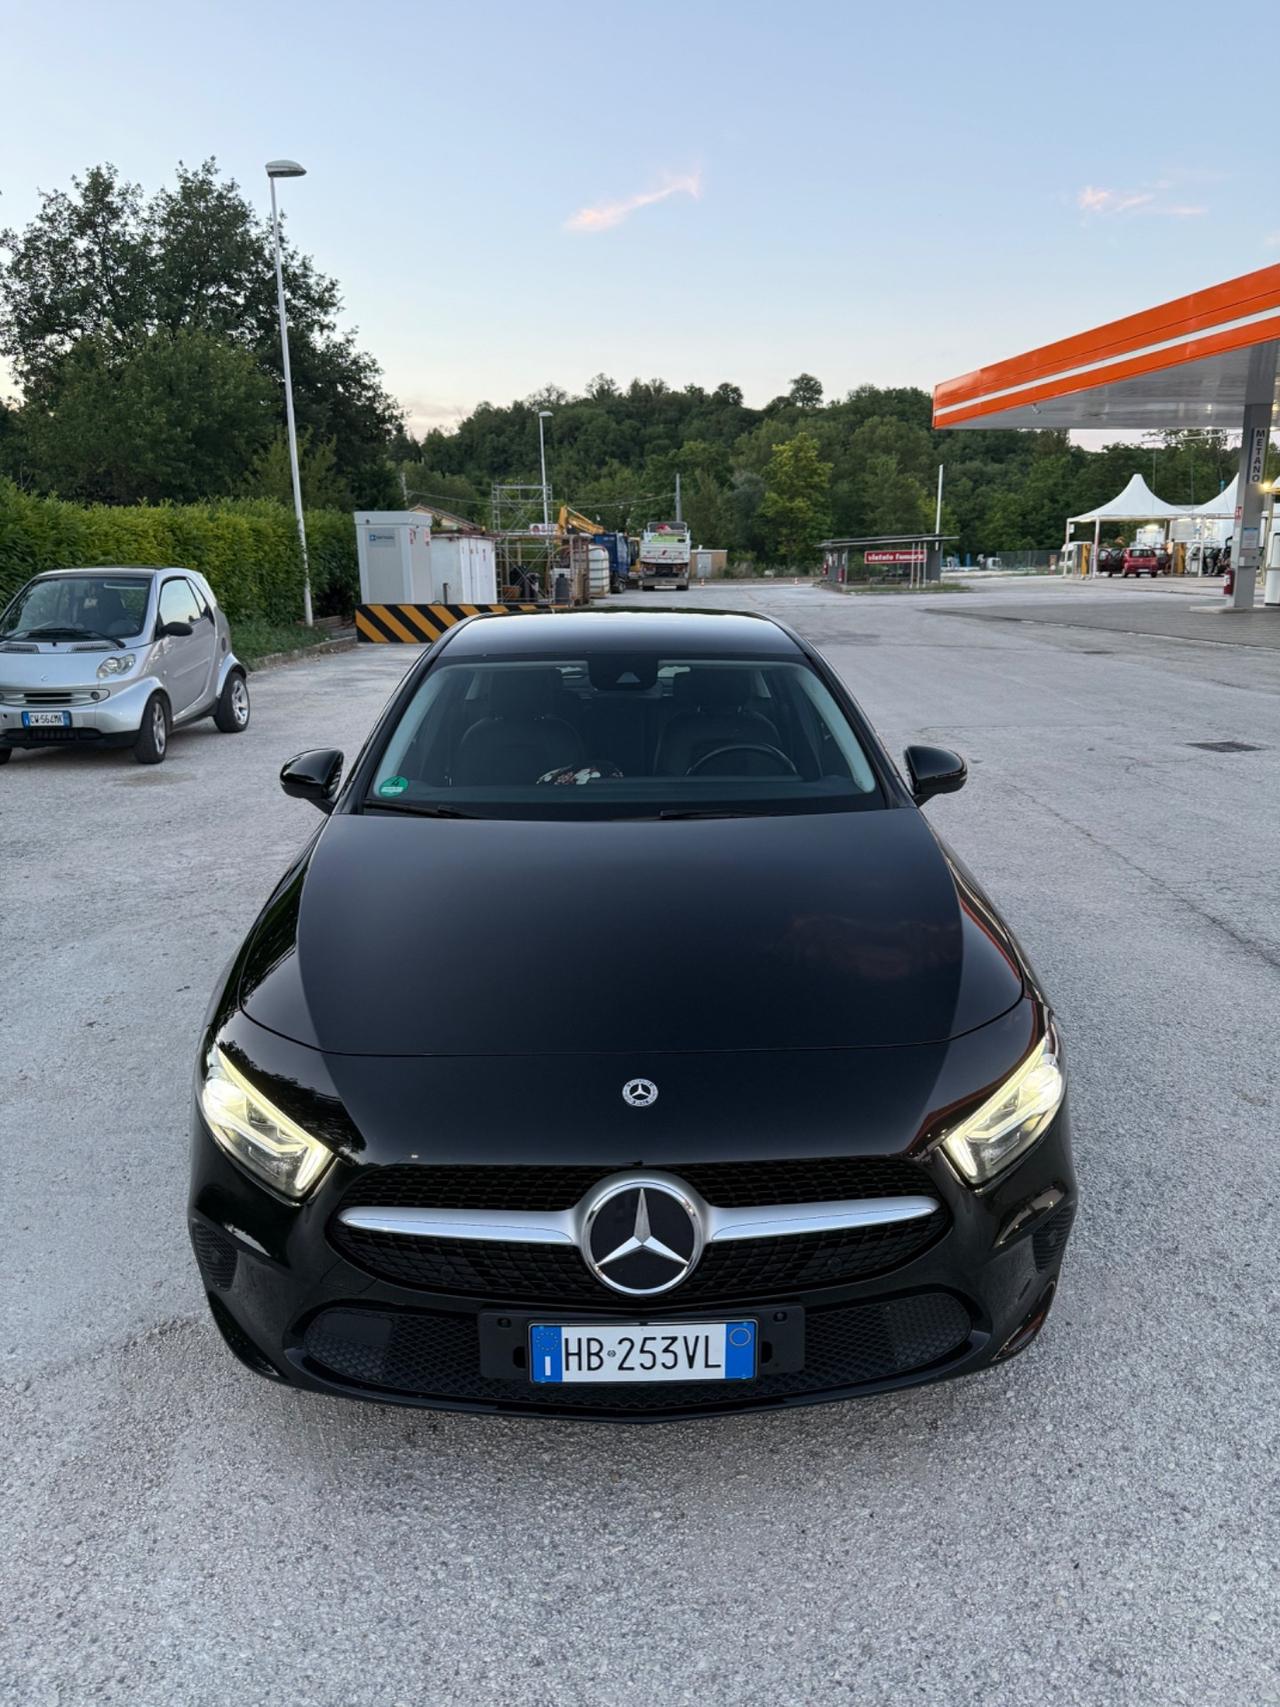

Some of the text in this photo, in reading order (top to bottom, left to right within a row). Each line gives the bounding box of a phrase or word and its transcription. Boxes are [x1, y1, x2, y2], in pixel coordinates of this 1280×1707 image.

[1252, 430, 1265, 482] METANO
[564, 1335, 722, 1371] HB 253VL
